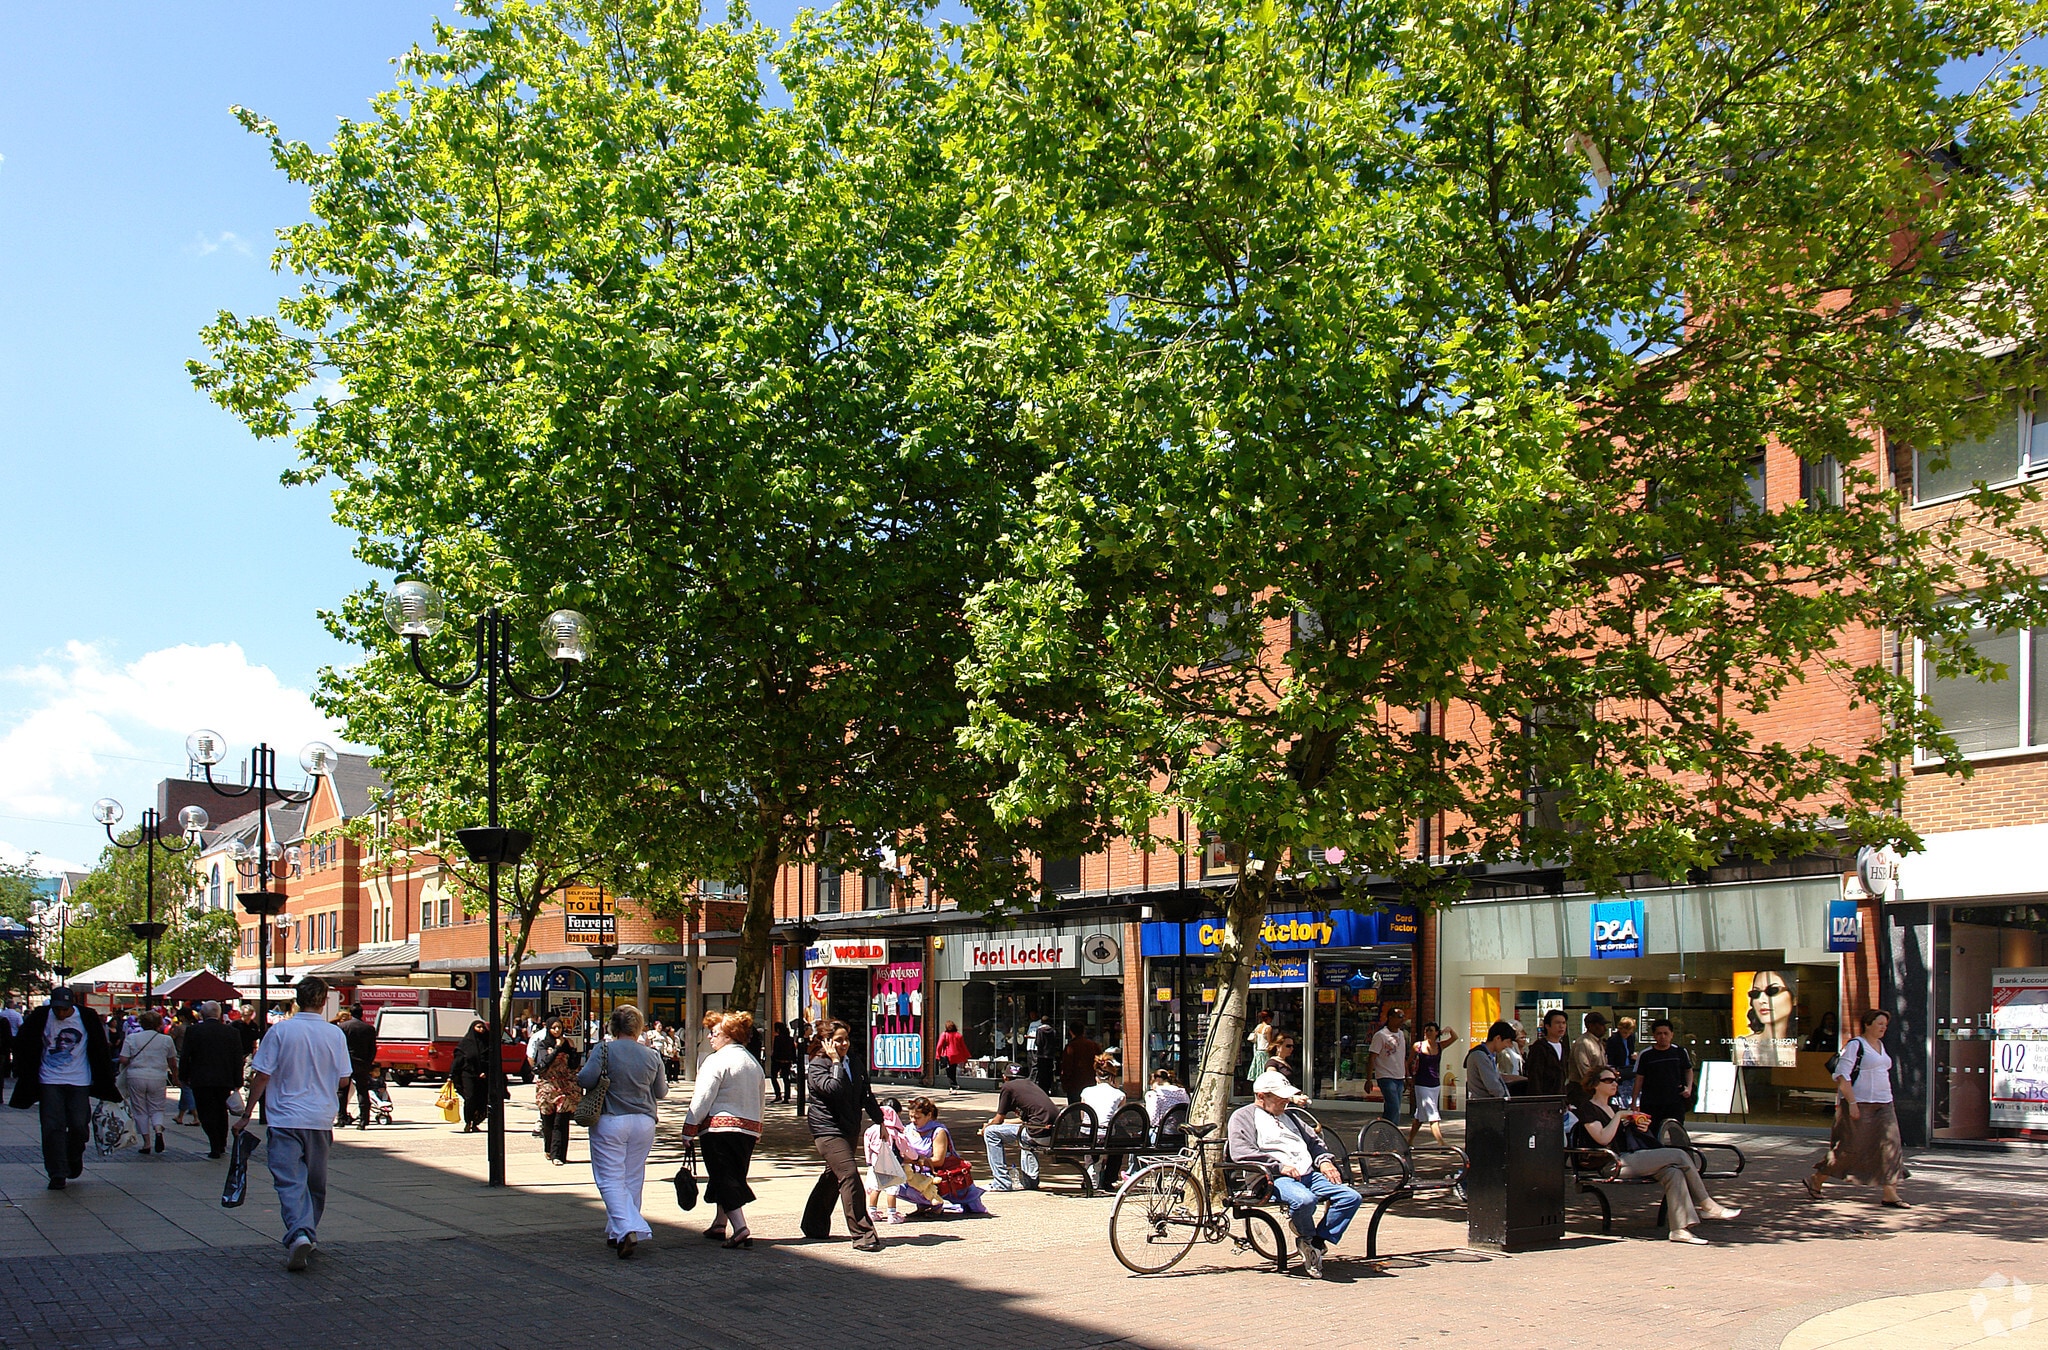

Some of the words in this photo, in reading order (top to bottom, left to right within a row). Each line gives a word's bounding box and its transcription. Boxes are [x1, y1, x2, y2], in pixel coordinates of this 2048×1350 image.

[1870, 866, 1889, 880] HSB
[567, 902, 585, 910] TO
[1395, 913, 1413, 923] Card
[1390, 923, 1418, 934] Factory
[1593, 919, 1639, 941] D&A
[1833, 917, 1857, 936] D&A
[568, 934, 580, 942] 020
[834, 945, 884, 960] WORLD
[973, 946, 1006, 966] Foot
[1010, 943, 1064, 965] Locker
[595, 971, 624, 983] Pundland
[896, 1036, 919, 1066] OFF
